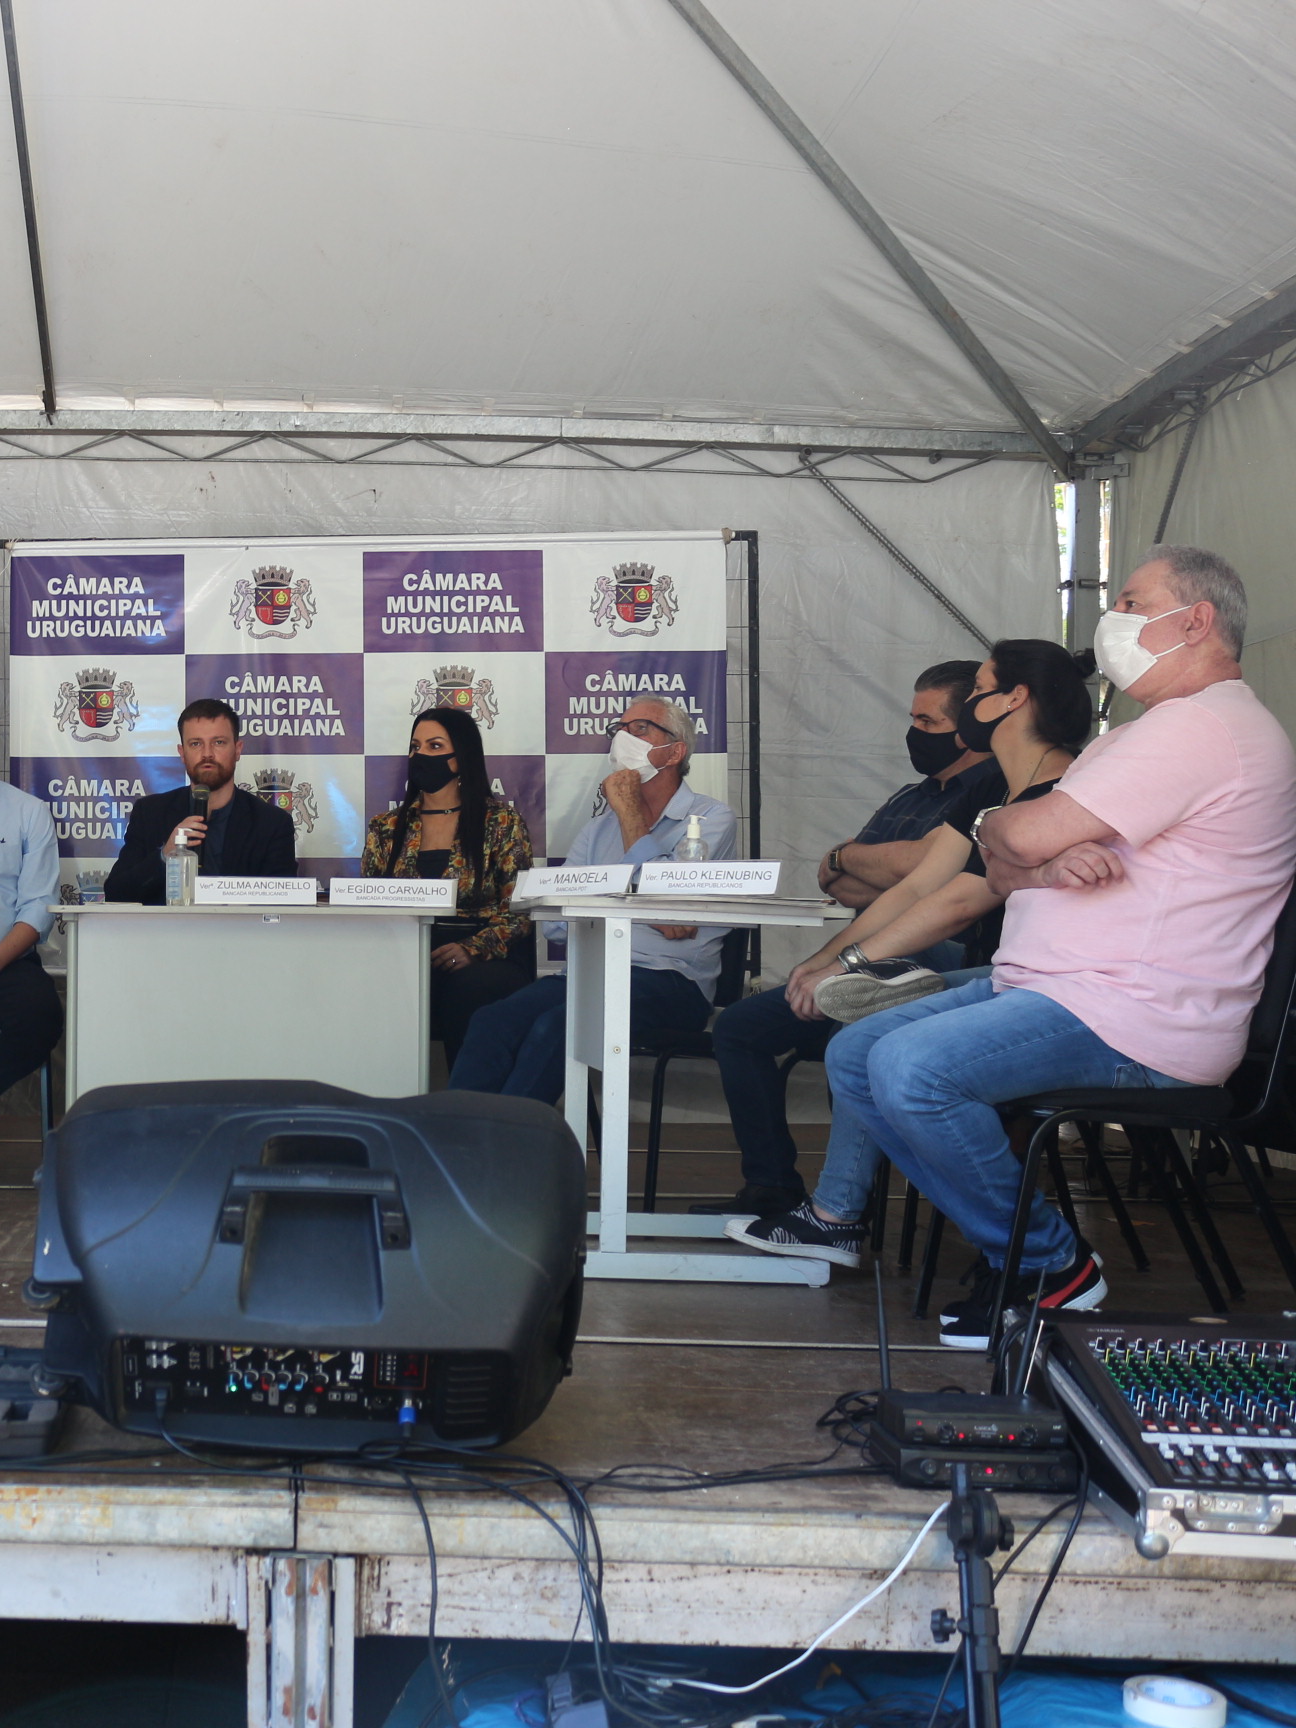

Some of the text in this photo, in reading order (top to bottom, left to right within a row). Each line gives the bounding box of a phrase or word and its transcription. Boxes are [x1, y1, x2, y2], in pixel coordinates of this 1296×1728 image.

[47, 573, 145, 595] CÂMARA
[402, 569, 503, 591] CÂMARA
[32, 598, 161, 618] MUNICIPAL
[386, 595, 520, 613] MUNICIPAL
[26, 619, 166, 638] URUGUAIANA
[381, 615, 525, 635] URUGUAIANA
[224, 672, 324, 694] CÂMARA
[585, 670, 686, 692] CÂMARA
[215, 698, 341, 716] UNICIPAL
[48, 775, 146, 797] CÂMARA
[217, 880, 252, 890] ZULMA
[253, 881, 311, 890] ANCINELLO
[553, 872, 608, 884] MANOELA
[660, 870, 698, 881] PAULO
[700, 870, 773, 881] KLEINUBING
[347, 882, 386, 892] EGÍDIO
[388, 883, 448, 896] CARVALHO
